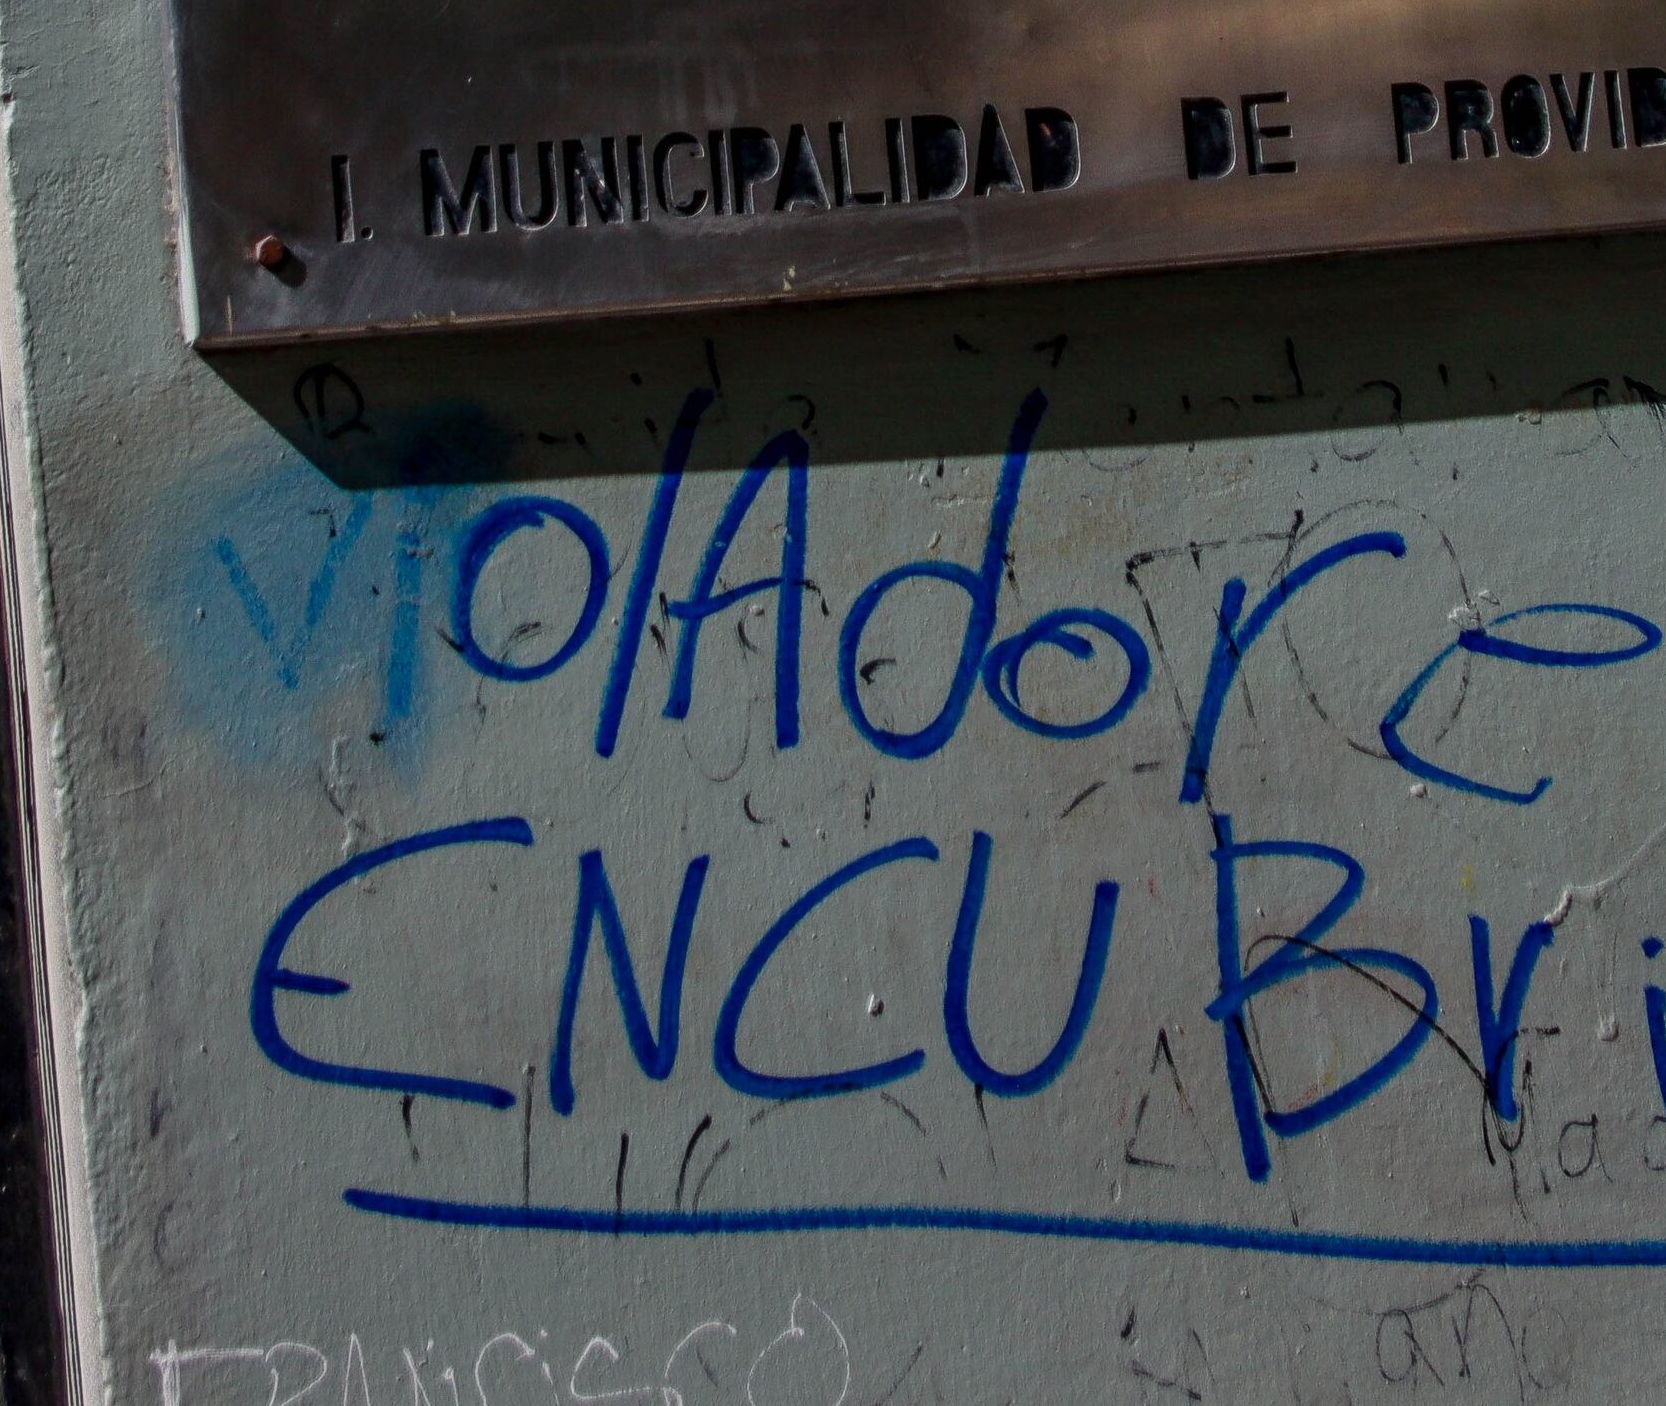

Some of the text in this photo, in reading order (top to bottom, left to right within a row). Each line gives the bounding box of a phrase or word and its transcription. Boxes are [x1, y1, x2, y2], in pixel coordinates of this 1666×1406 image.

[331, 152, 374, 244] I.
[419, 103, 1082, 237] MUNICIPALIDAD
[1180, 91, 1298, 181] DE
